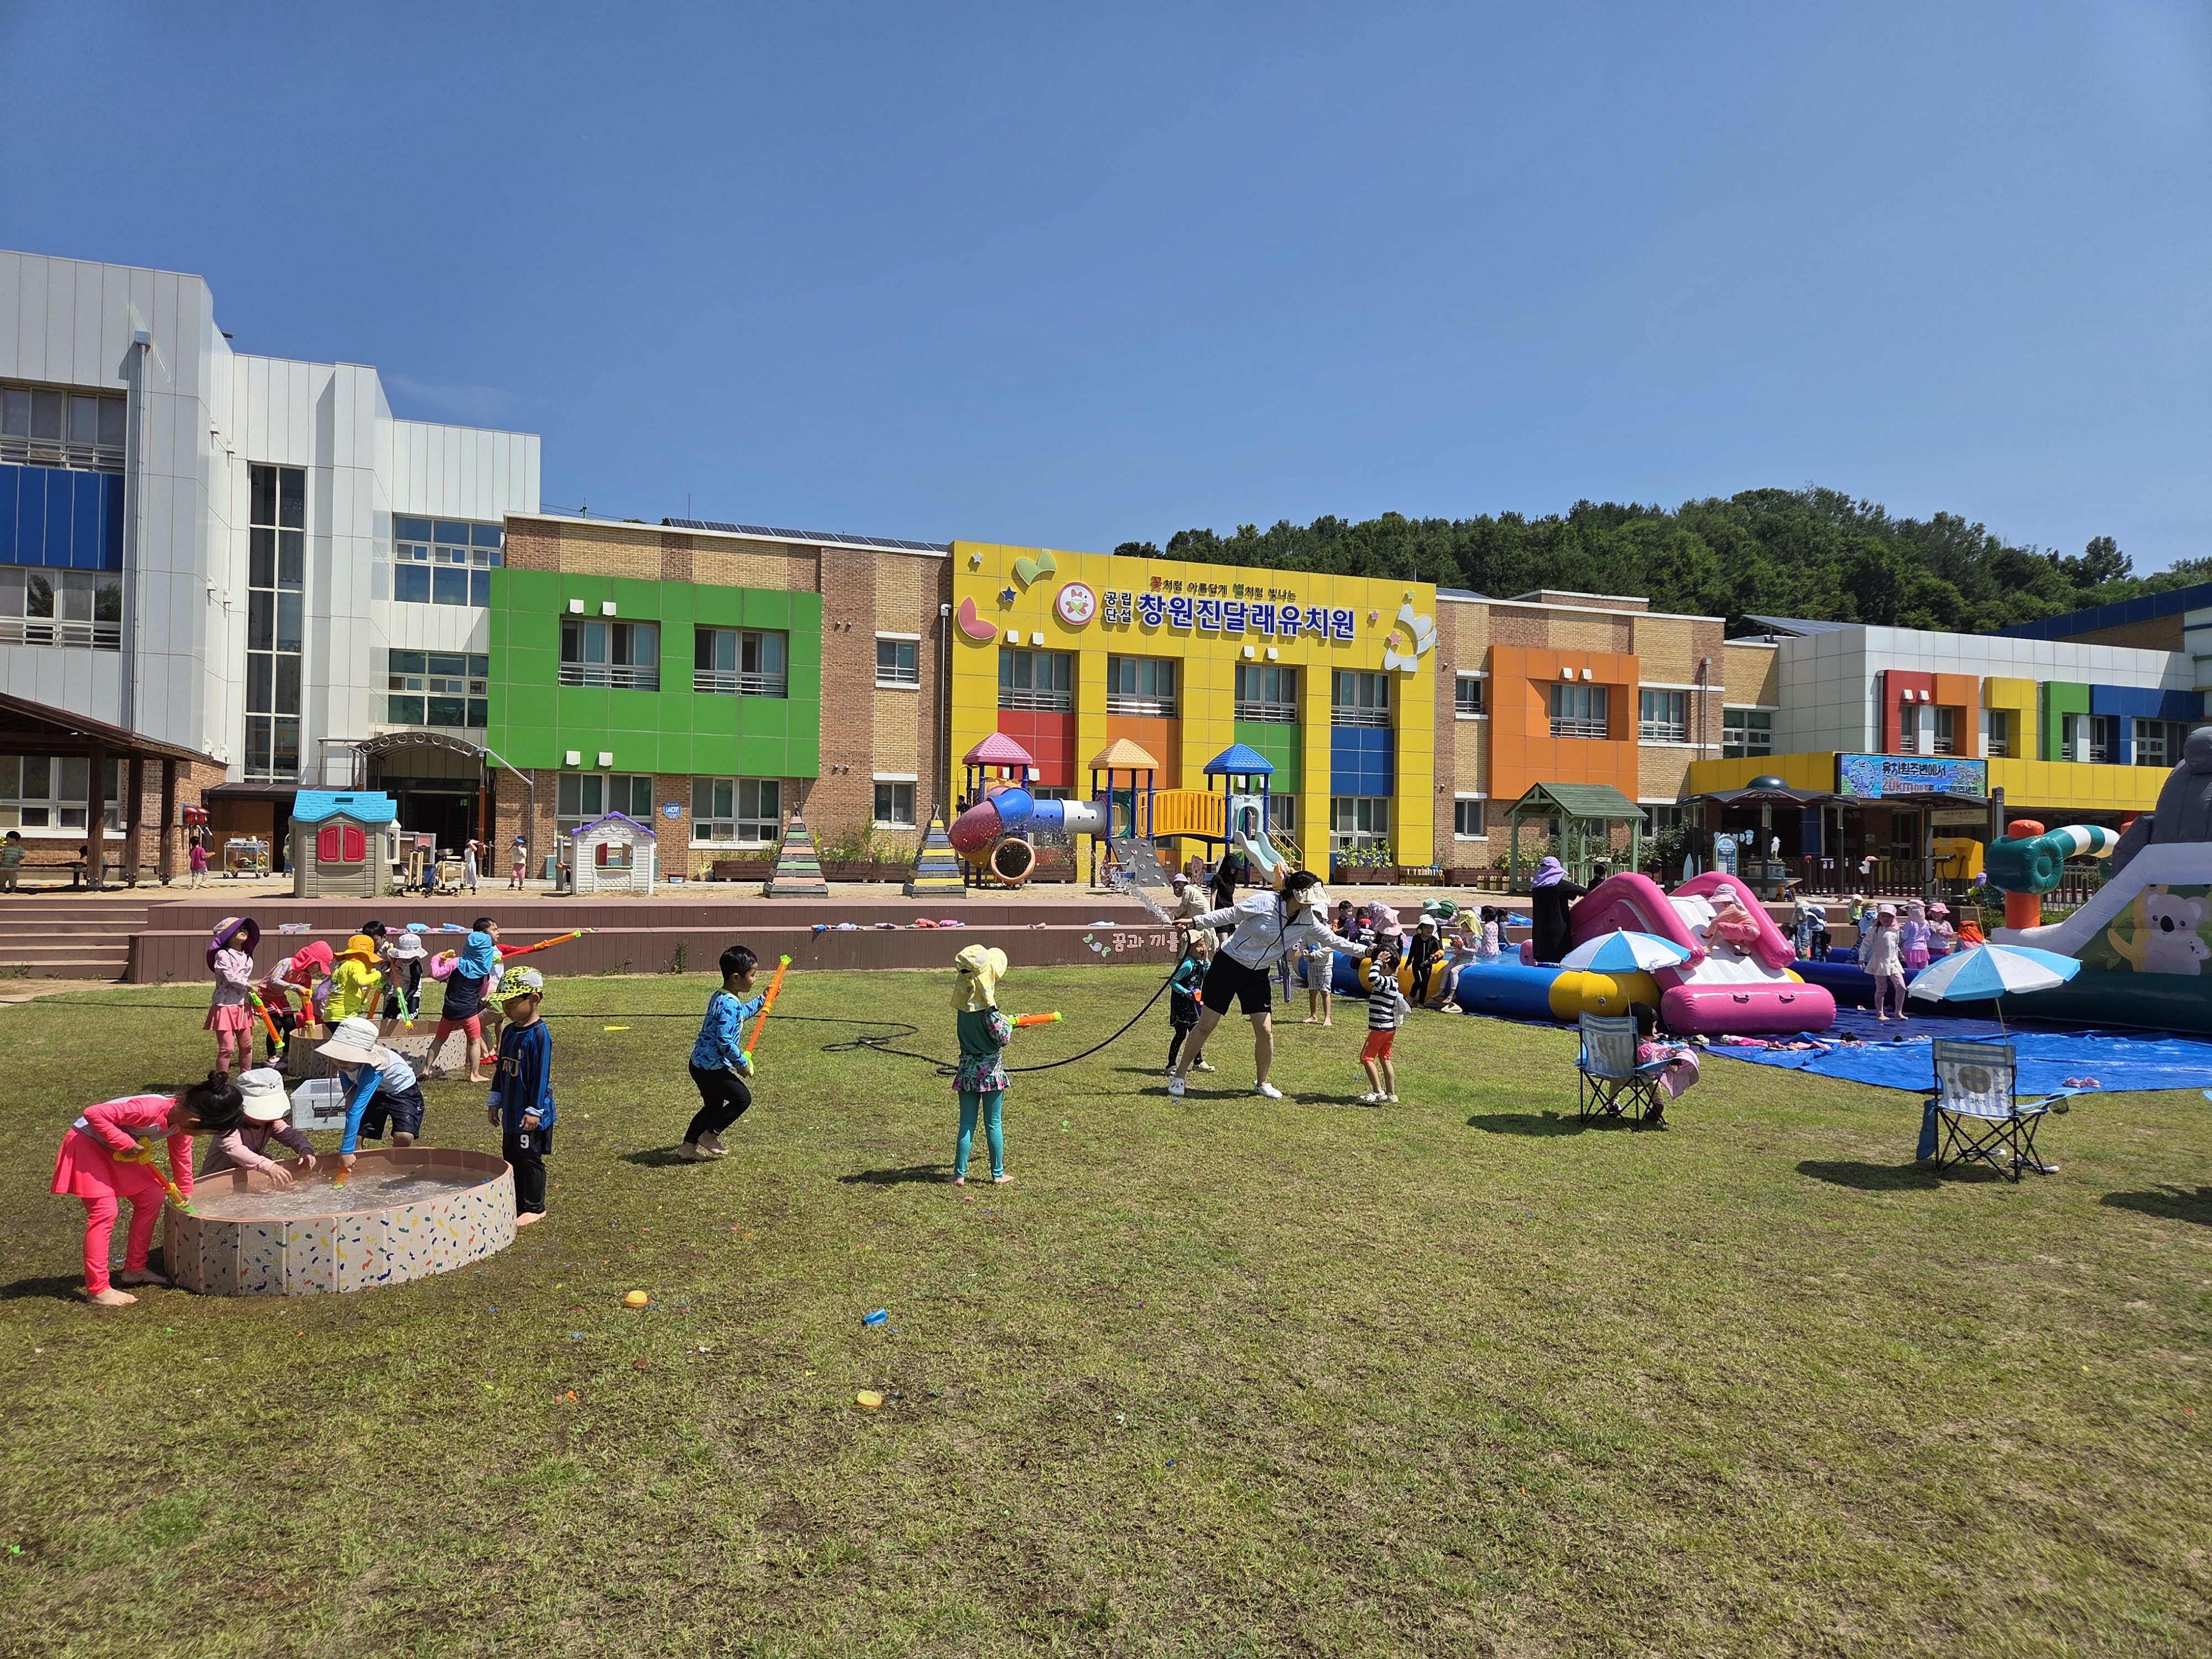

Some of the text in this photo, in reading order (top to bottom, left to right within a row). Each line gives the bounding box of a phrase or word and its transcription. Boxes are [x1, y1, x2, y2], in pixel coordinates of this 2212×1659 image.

[1150, 576, 1297, 600] 꽃처럼 아름답게 별처럼 빛나는
[1105, 591, 1131, 607] 공립
[1105, 608, 1131, 623] 단설
[1137, 593, 1355, 639] 창원진달래유치원
[1113, 931, 1180, 952] 꿈과 끼를
[520, 1134, 529, 1149] 9
